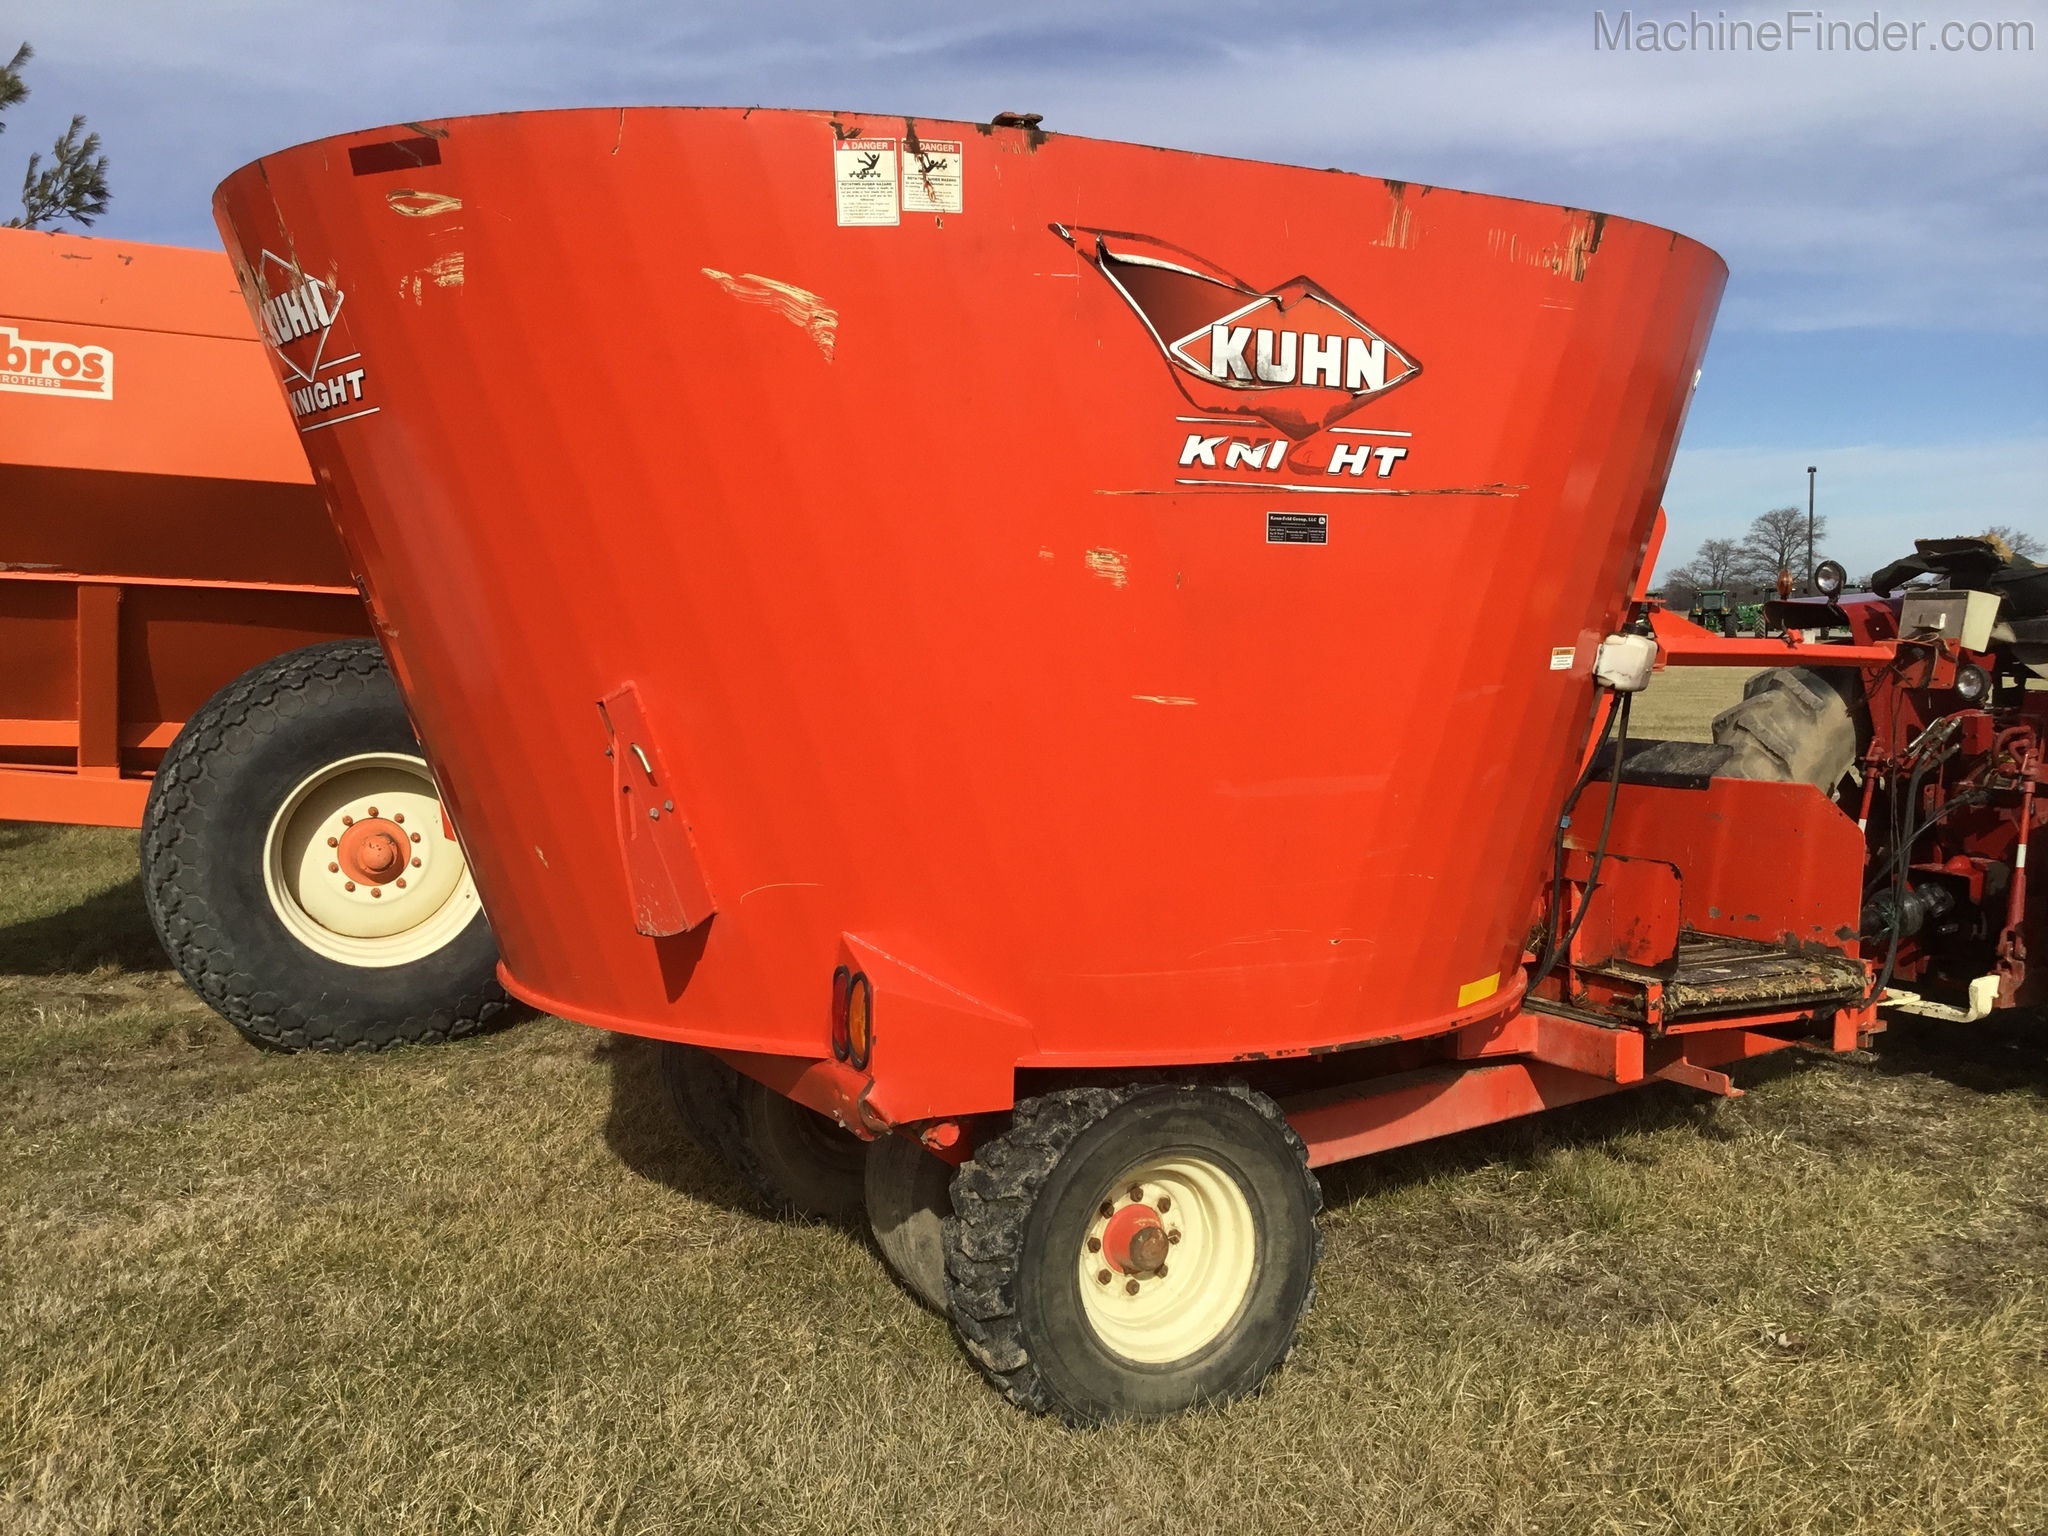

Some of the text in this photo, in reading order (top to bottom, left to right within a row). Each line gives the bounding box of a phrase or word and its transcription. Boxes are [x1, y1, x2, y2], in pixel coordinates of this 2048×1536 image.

[851, 142, 889, 150] DANGER
[919, 143, 955, 152] DANGER
[0, 333, 105, 380] bros
[1211, 324, 1387, 391] KUHN
[0, 374, 61, 388] ROTHERS
[289, 368, 366, 417] KNIGHT
